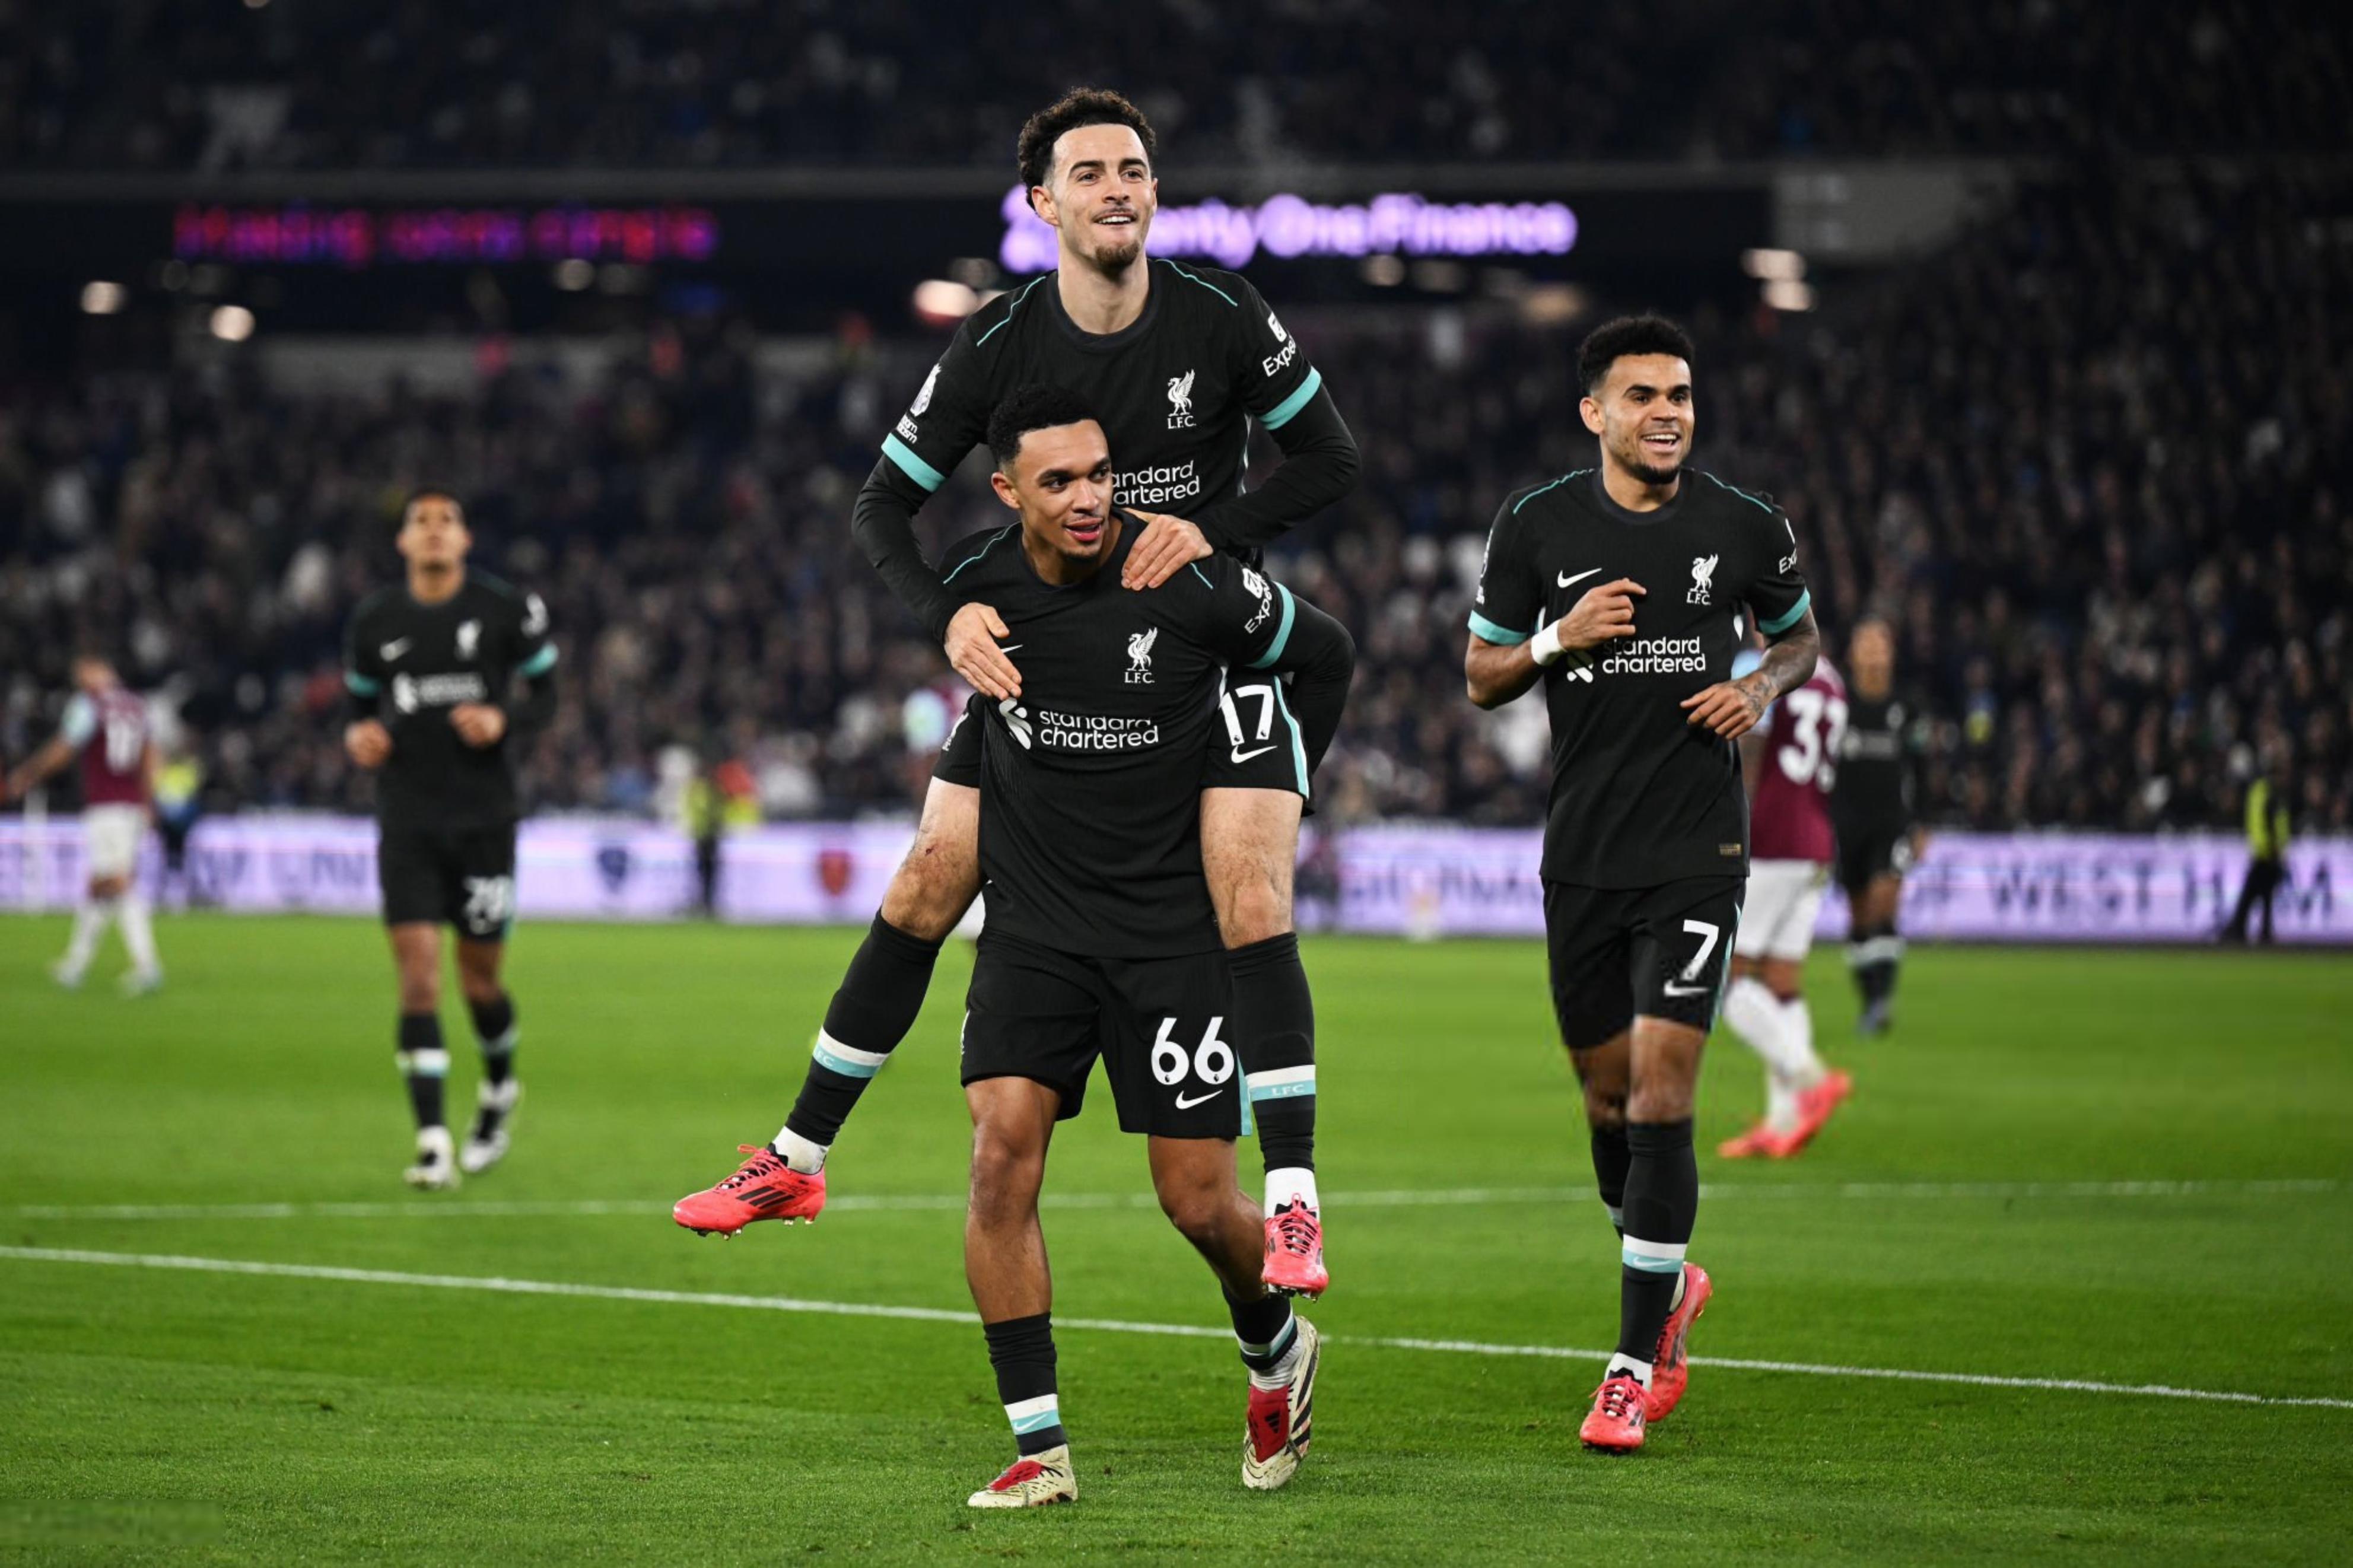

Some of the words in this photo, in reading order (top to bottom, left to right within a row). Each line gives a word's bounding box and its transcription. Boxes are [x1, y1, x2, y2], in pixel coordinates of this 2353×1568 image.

[1112, 460, 1194, 488] andard
[1113, 475, 1200, 505] artered
[1602, 653, 1706, 673] chartered
[1221, 684, 1274, 746] 17
[1041, 726, 1159, 749] chartered
[1683, 919, 1719, 981] 7
[1151, 1016, 1235, 1085] 66
[1271, 1084, 1305, 1096] LFC
